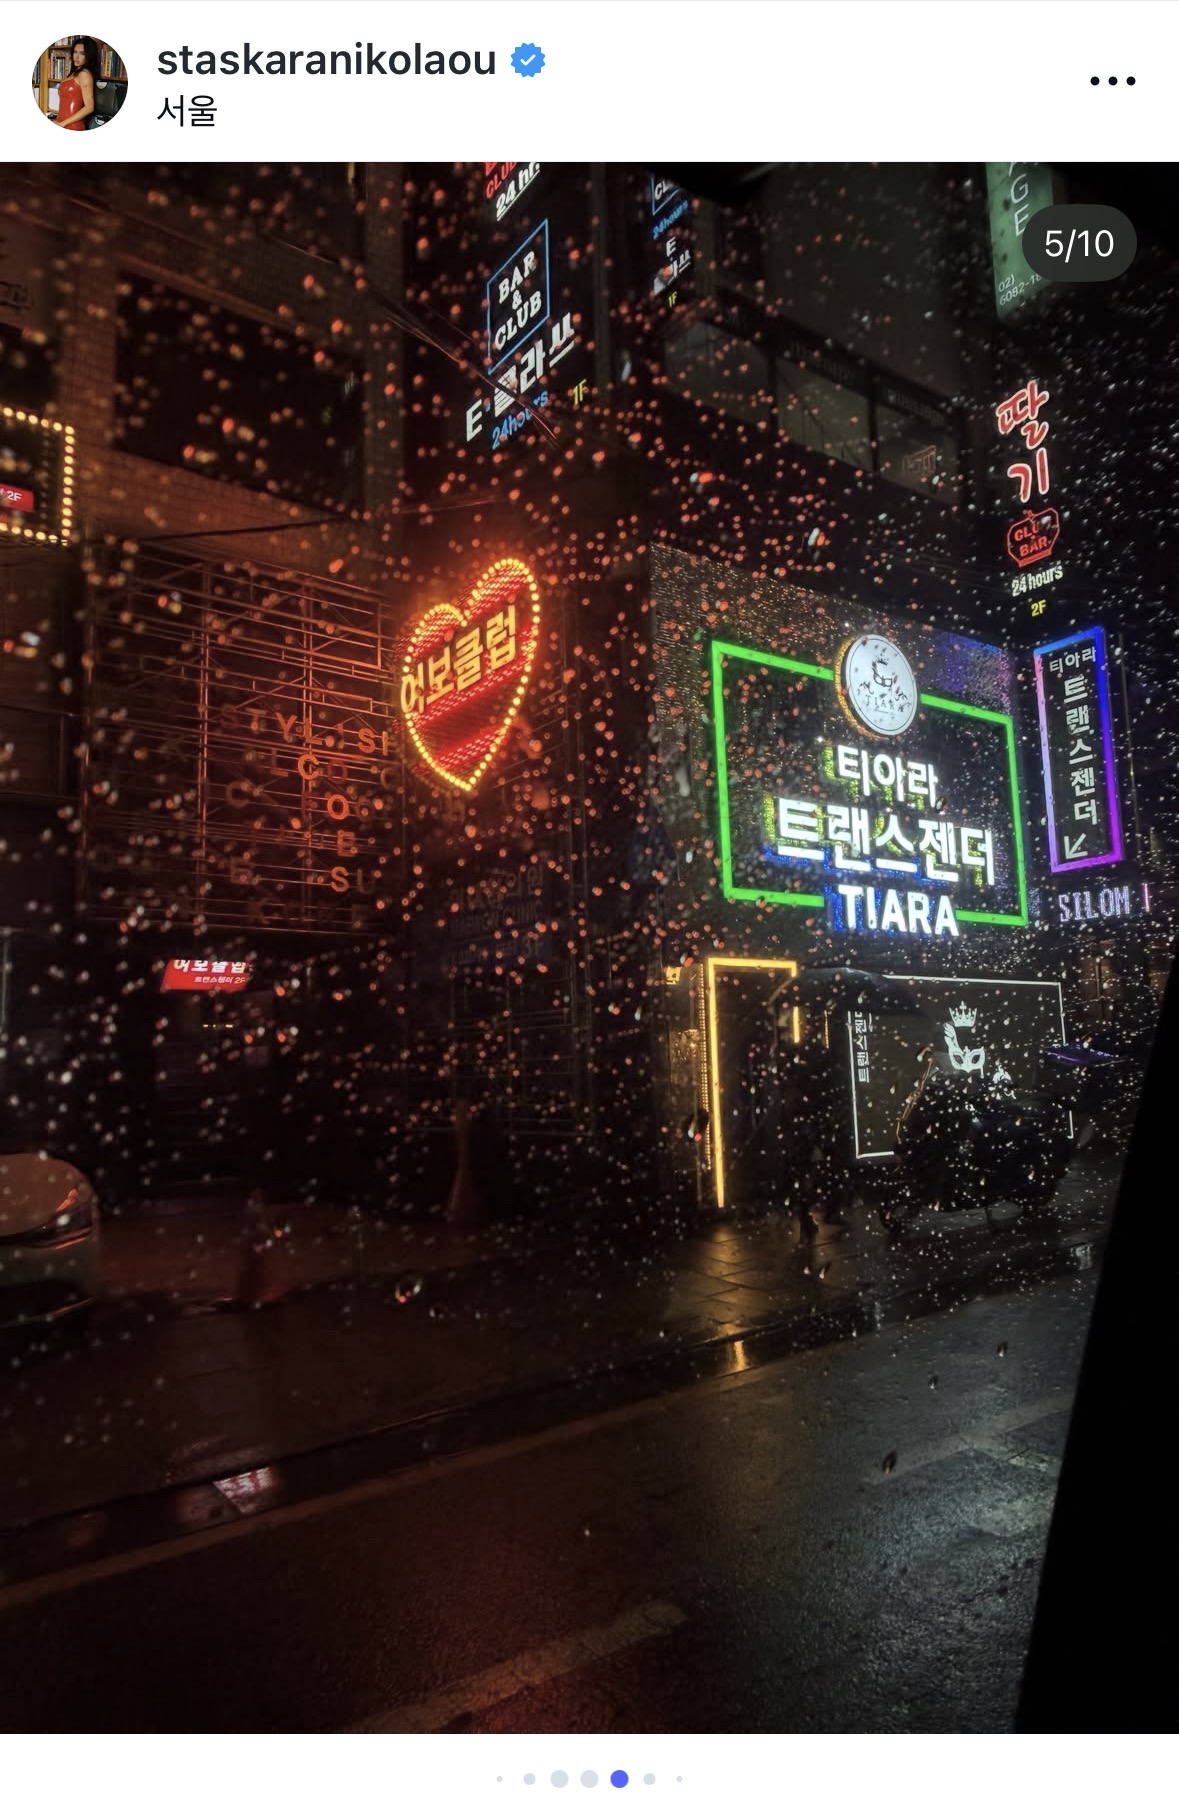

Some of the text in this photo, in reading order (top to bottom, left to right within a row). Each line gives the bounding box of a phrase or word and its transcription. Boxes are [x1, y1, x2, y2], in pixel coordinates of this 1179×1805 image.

[486, 162, 517, 198] CLU
[499, 251, 537, 304] BAR
[495, 291, 542, 351] CLUB
[572, 378, 588, 406] 1F
[996, 380, 1050, 502] 딸기
[1014, 516, 1051, 541] CLU
[1030, 599, 1047, 617] 2F
[400, 605, 516, 714] 여보클럽
[1049, 647, 1097, 673] 티아라
[836, 744, 938, 808] 티아라
[1064, 673, 1098, 826] 트랜스젠더
[776, 796, 995, 887] 트랜스젠더
[837, 884, 960, 937] TIARA
[1058, 885, 1131, 922] SILOM
[854, 1010, 870, 1083] 트랜스젠
